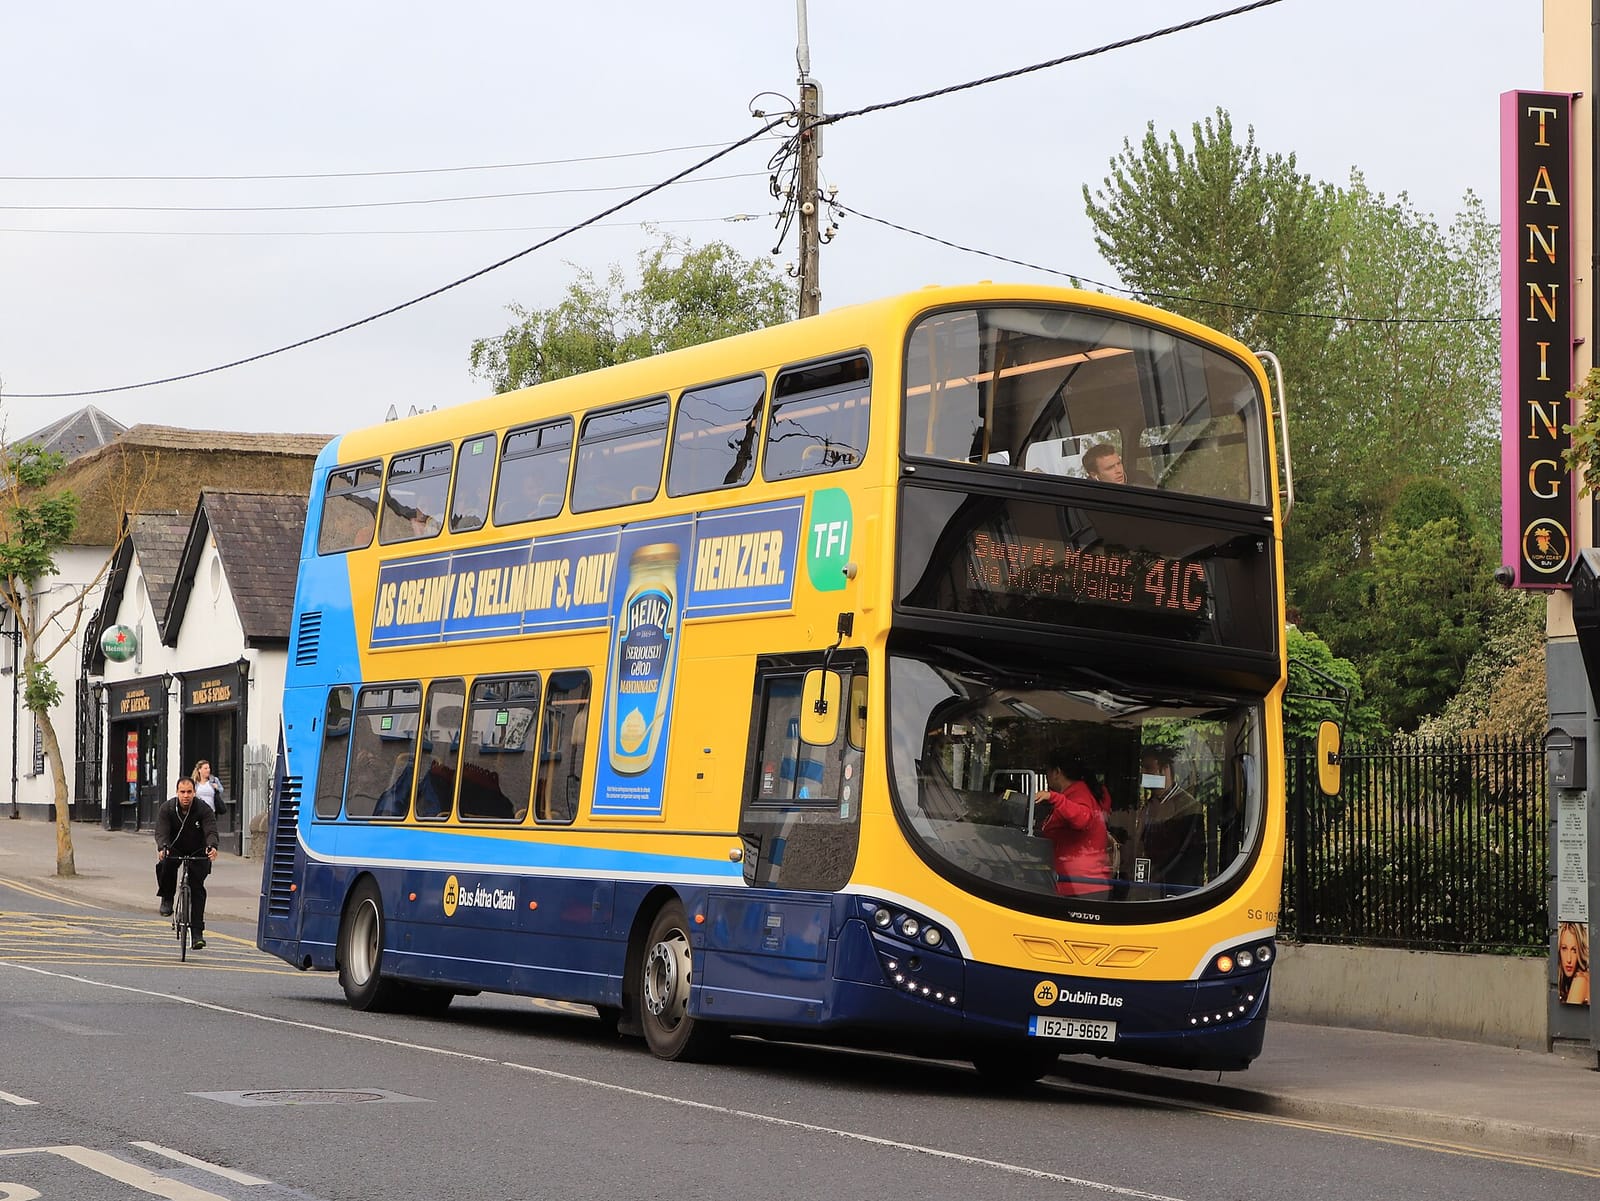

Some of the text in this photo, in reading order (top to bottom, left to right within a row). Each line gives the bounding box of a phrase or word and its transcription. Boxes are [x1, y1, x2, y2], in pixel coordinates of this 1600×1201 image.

[1525, 105, 1561, 500] TANNING
[813, 520, 849, 559] TFI
[375, 529, 785, 628] AS CREAMY AS HELLMANN'S, ONLY HEINZIER.
[974, 533, 1205, 612] Swords Manor 41C
[1008, 563, 1065, 593] River
[1072, 572, 1134, 603] Valley
[630, 599, 668, 632] HEINZ
[619, 678, 659, 694] MAYONNAISE
[458, 882, 516, 911] Bus Átha Cliath
[1247, 908, 1263, 920] SG
[1058, 989, 1124, 1007] Dublin Bus
[1043, 1020, 1109, 1040] 152-D-9662
